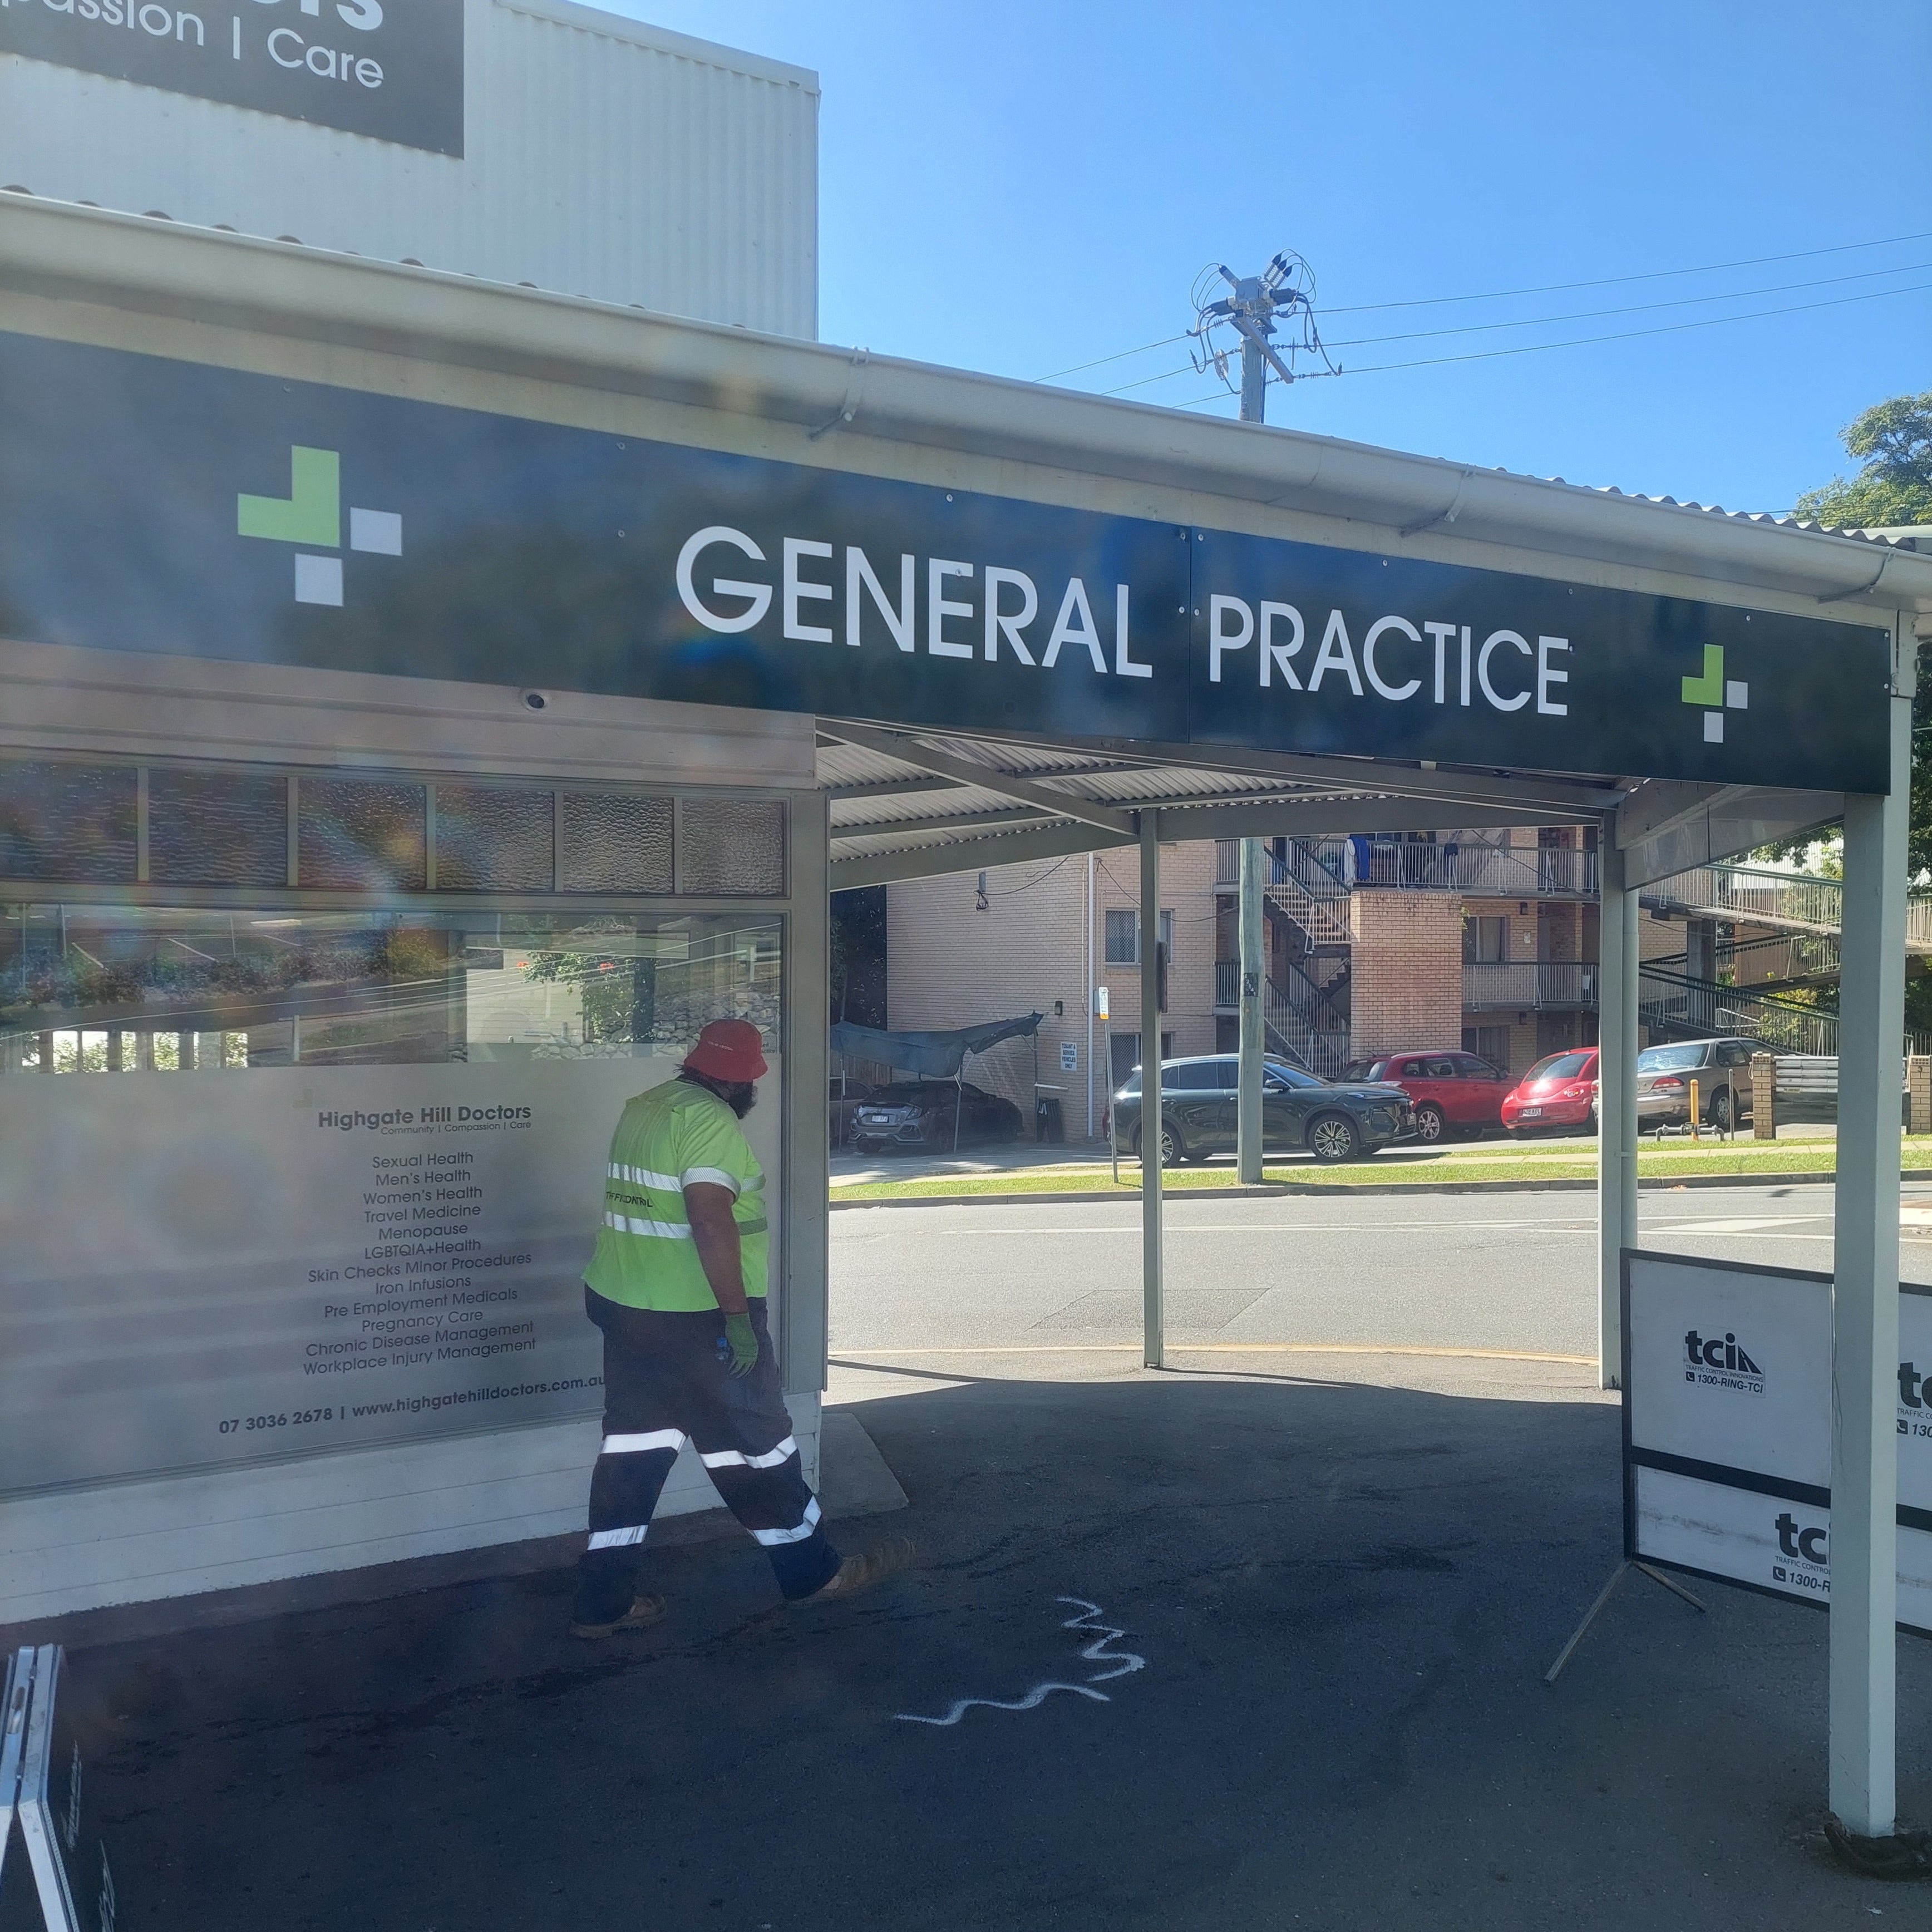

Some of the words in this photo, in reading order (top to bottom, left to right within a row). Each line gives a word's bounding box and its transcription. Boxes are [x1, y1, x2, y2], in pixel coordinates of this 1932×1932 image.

[267, 28, 384, 88] Care
[676, 526, 1153, 678] GENERAL
[1209, 594, 1569, 716] PRACTICE
[318, 1109, 414, 1131] Highgate
[421, 1106, 451, 1123] Hill
[457, 1105, 531, 1121] Doctors
[381, 1125, 435, 1135] Community
[445, 1122, 500, 1132] Compassion
[510, 1121, 531, 1129] Care
[372, 1154, 422, 1169] Sexual
[427, 1152, 474, 1165] Health
[376, 1172, 420, 1186] Men's
[425, 1170, 471, 1183] Health
[363, 1189, 432, 1205] Women's
[436, 1186, 482, 1200] Health
[364, 1209, 407, 1223] Travel
[413, 1205, 481, 1220] Medicine
[379, 1224, 467, 1240] Menopause
[365, 1239, 481, 1259] LGBTQIA+Health
[308, 1268, 339, 1283] Skin
[344, 1263, 401, 1279] Checks
[452, 1253, 532, 1270] Procedures
[376, 1282, 403, 1295] Iron
[409, 1276, 471, 1292] Infusions
[325, 1305, 348, 1318] Pre
[354, 1297, 447, 1317] Employment
[452, 1288, 518, 1305] Medicals
[362, 1314, 443, 1335] Pregnancy
[448, 1310, 484, 1324] Care
[306, 1342, 368, 1357] Chronic
[373, 1334, 431, 1349] Disease
[435, 1320, 534, 1343] Management
[304, 1355, 387, 1376] Workplace
[392, 1350, 433, 1367] Injury
[438, 1338, 536, 1361] Management
[1685, 1330, 1736, 1371] tci
[1685, 1364, 1704, 1373] TRAFFIC
[1706, 1368, 1729, 1377] CONTROL
[1697, 1374, 1763, 1393] 1300-RING-TCI
[219, 1419, 239, 1435] 07
[245, 1413, 288, 1430] 3036
[293, 1407, 333, 1425] 2678
[353, 1376, 605, 1417] www.highgatehilldoctors.com.au
[1897, 1407, 1925, 1418] TRAFFIC
[1775, 1555, 1801, 1568] TRAFFIC
